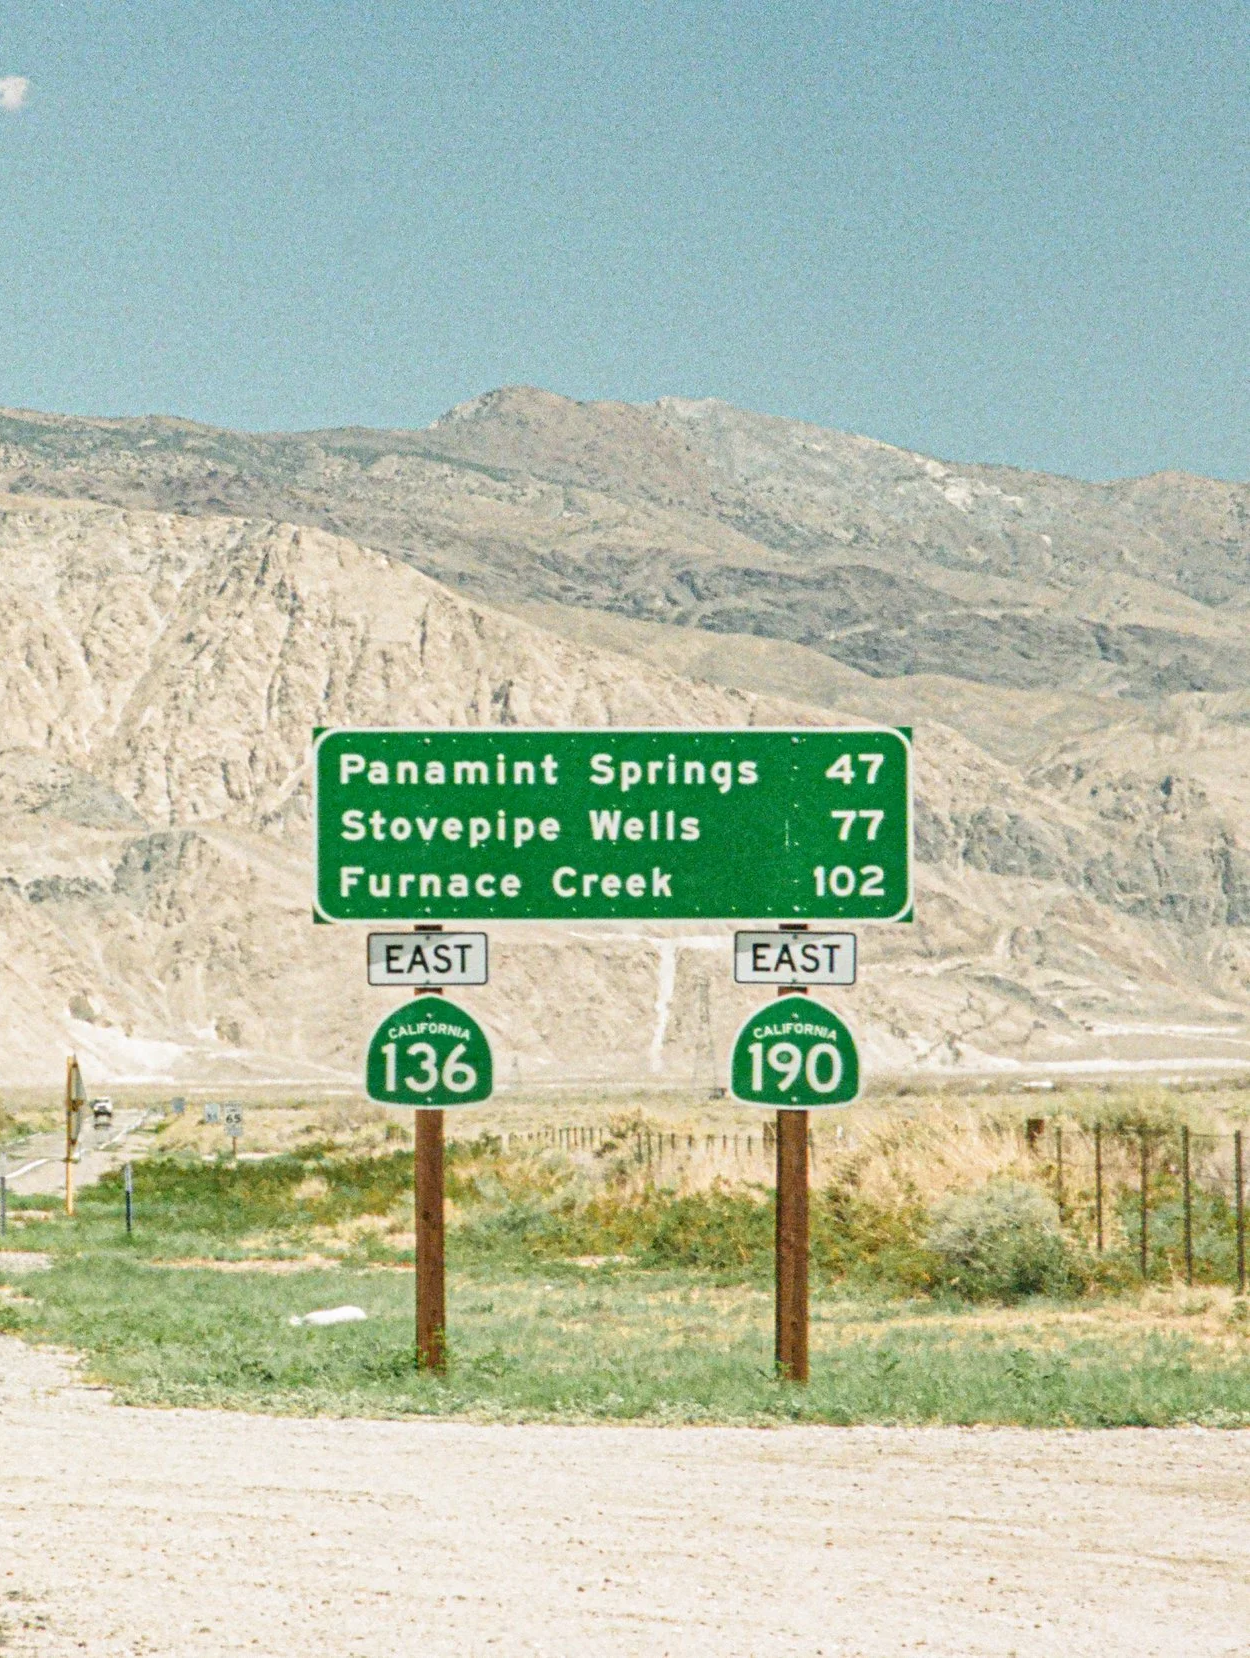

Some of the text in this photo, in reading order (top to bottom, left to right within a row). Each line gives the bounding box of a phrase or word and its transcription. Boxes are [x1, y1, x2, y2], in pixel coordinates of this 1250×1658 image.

[340, 753, 885, 794] Panamint Springs 47
[341, 809, 885, 848] Stovepipe Wells 77
[340, 865, 886, 898] Furnace Creek 102
[385, 944, 472, 974] EAST
[752, 943, 840, 973] EAST
[388, 1022, 471, 1041] CALIFORNIA
[753, 1022, 837, 1041] CALIFORNIA
[381, 1042, 477, 1093] 136
[747, 1042, 843, 1093] 190
[225, 1113, 242, 1124] 65
